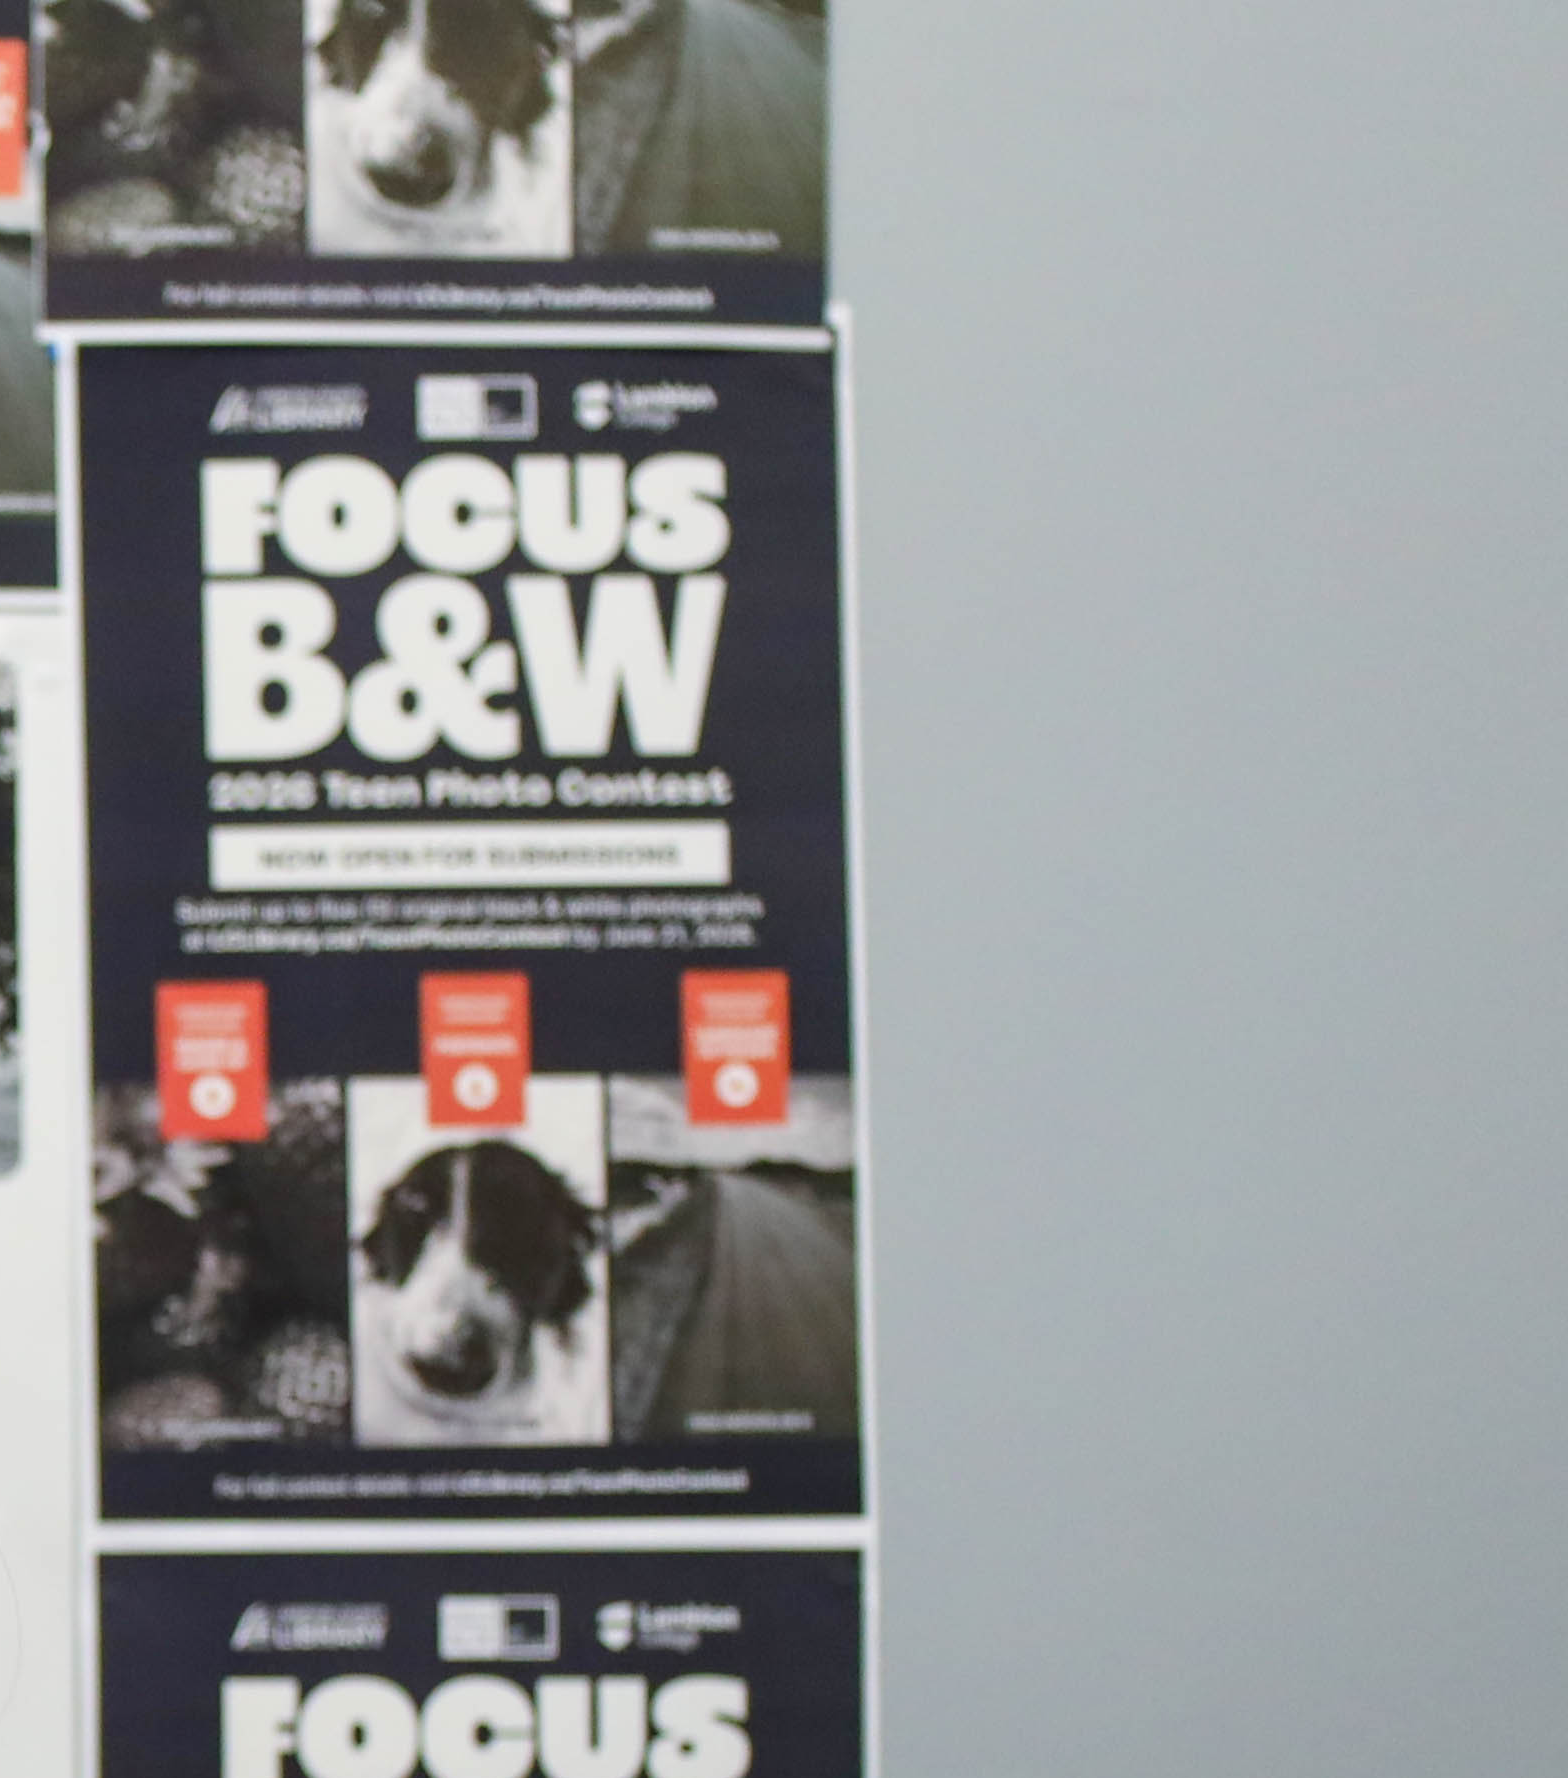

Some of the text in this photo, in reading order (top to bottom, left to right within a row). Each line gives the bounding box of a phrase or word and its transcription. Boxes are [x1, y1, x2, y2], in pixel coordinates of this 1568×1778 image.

[200, 452, 732, 577] FOCUS
[201, 573, 728, 762] B&W
[210, 770, 731, 808] 2026 Teen Photo Contest
[258, 845, 682, 867] NOW OPEN FOR SUBMISSIONS
